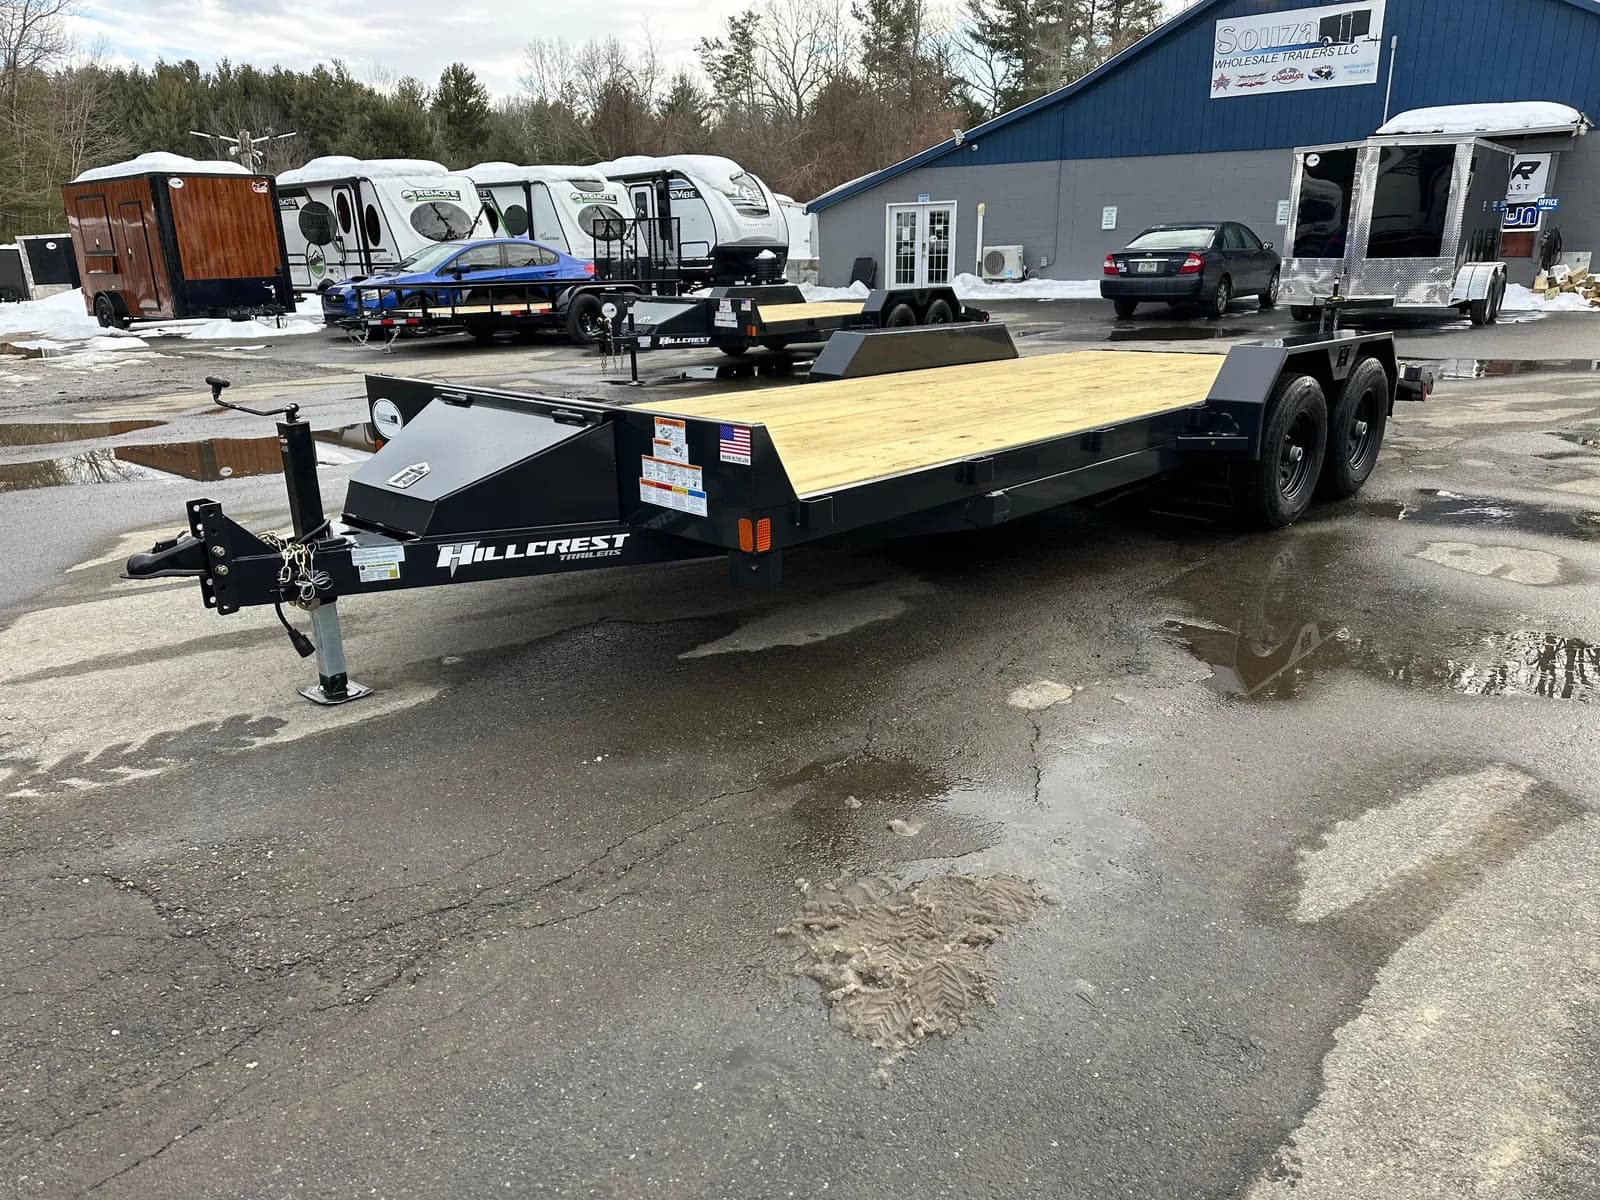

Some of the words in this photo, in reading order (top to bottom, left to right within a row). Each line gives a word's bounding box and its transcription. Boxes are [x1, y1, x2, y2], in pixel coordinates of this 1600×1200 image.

[1215, 22, 1318, 54] Souza
[1215, 54, 1279, 69] WHOLESALE
[1282, 46, 1335, 62] TRAILERS
[1337, 44, 1360, 56] LLC
[1538, 198, 1559, 207] OFFICE
[436, 533, 631, 570] HILLCREST
[560, 549, 622, 561] TRAILERS
